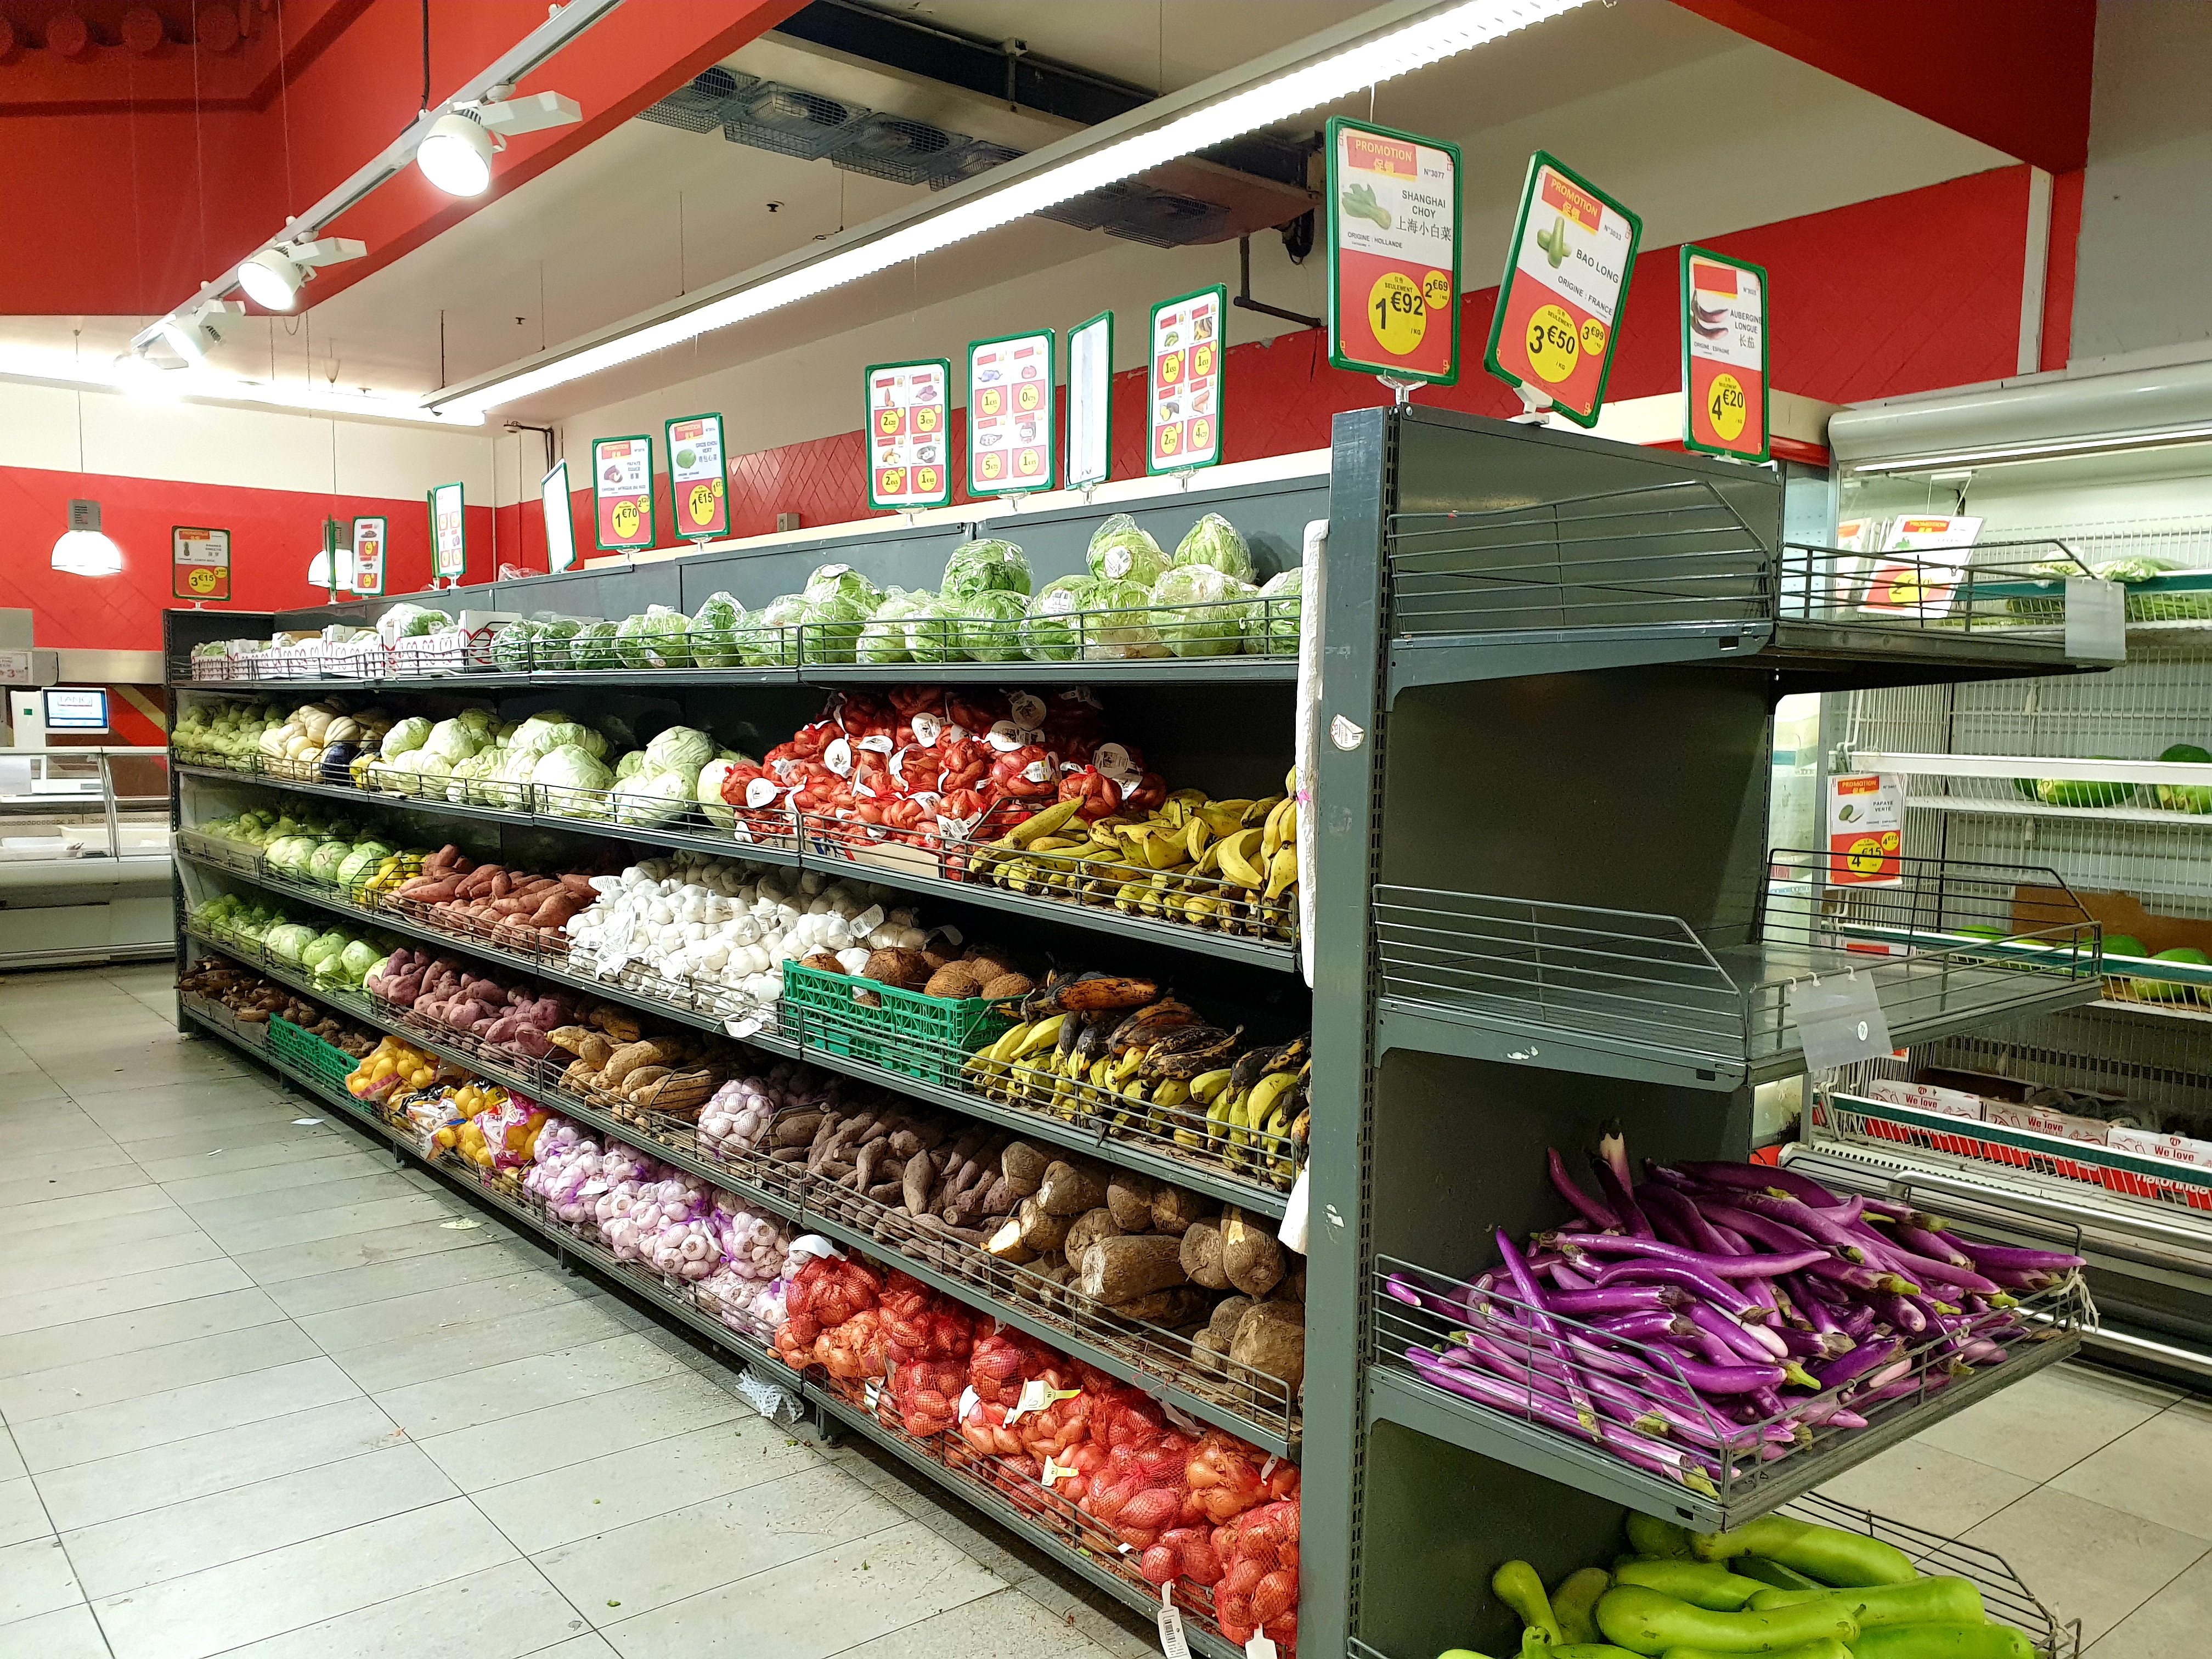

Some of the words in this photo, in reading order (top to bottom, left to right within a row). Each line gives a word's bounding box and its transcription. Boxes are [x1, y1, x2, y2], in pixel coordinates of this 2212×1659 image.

[1355, 139, 1413, 161] PROMOTION
[1402, 190, 1446, 208] SHANGHAI
[1550, 178, 1598, 217] PROMOTION
[1412, 206, 1436, 219] CHOY
[1396, 216, 1452, 241] 上海小白菜
[1347, 232, 1370, 242] ORIGINE
[1374, 238, 1402, 249] HOLLANDE
[1576, 249, 1594, 267] BAO
[1596, 262, 1619, 284] LONG
[1425, 279, 1448, 298] 2€69
[1558, 276, 1583, 297] ORIGINE
[1588, 295, 1613, 315] FRANCE
[1376, 291, 1423, 330] 1€92
[1735, 323, 1757, 334] LONGUE
[1529, 325, 1575, 354] 3€50
[1712, 389, 1743, 420] 4€20
[692, 493, 713, 514] 1€15
[616, 508, 637, 527] 1€70
[1906, 1094, 1918, 1104] We
[1921, 1097, 1937, 1108] love
[2028, 1116, 2041, 1127] We
[2044, 1120, 2063, 1132] love
[2155, 1146, 2170, 1157] We
[2174, 1149, 2194, 1161] love
